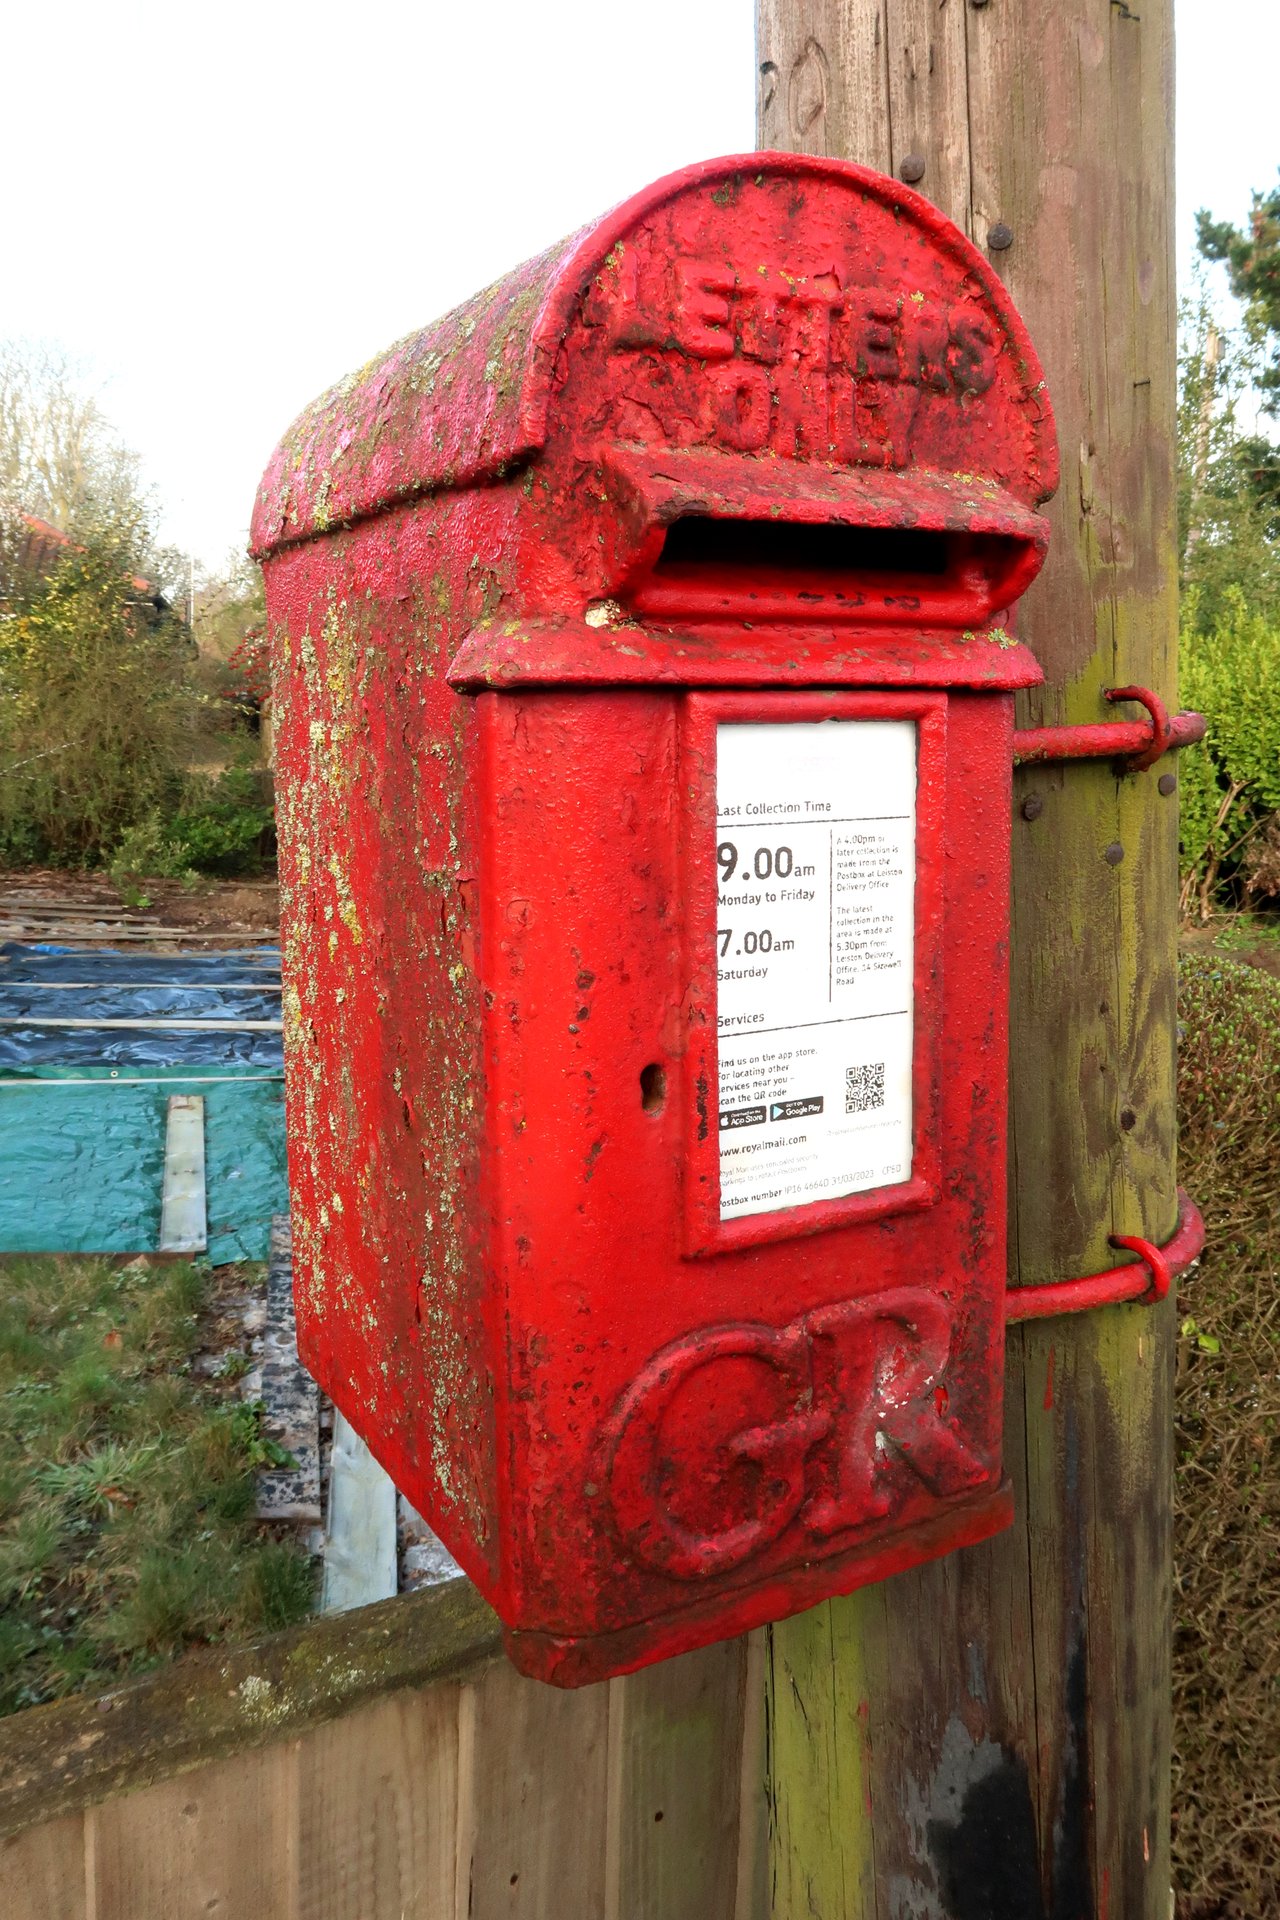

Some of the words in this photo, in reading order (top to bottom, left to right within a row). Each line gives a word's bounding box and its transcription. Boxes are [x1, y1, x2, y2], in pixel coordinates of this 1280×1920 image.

[717, 805, 741, 816] Last
[746, 802, 800, 815] Collection
[805, 801, 831, 812] Time
[844, 835, 876, 845] 4.00pm
[892, 845, 898, 853] is
[837, 860, 856, 868] made
[837, 872, 865, 880] Postbox
[836, 883, 866, 891] Delivery
[869, 881, 889, 889] Office
[717, 894, 761, 906] Monday
[766, 892, 776, 902] to
[780, 890, 815, 901] Friday
[836, 917, 870, 926] collection
[863, 926, 883, 935] made
[718, 929, 795, 956] 7.00am
[836, 941, 867, 951] 5.30pm
[717, 966, 768, 981] Saturday
[836, 977, 854, 986] Road
[718, 1012, 764, 1027] Services
[749, 1056, 759, 1064] on
[762, 1053, 775, 1061] the
[778, 1052, 792, 1060] app
[733, 1068, 765, 1078] locating
[768, 1064, 789, 1074] other
[753, 1079, 771, 1088] near
[774, 1076, 788, 1087] you
[738, 1093, 751, 1103] the
[754, 1091, 765, 1100] QR
[768, 1088, 787, 1098] code
[786, 1106, 807, 1116] Google
[808, 1104, 821, 1112] Play
[731, 1117, 745, 1126] App
[746, 1115, 764, 1123] Store
[751, 1189, 782, 1201] number
[831, 1170, 874, 1186] 31/03/2023
